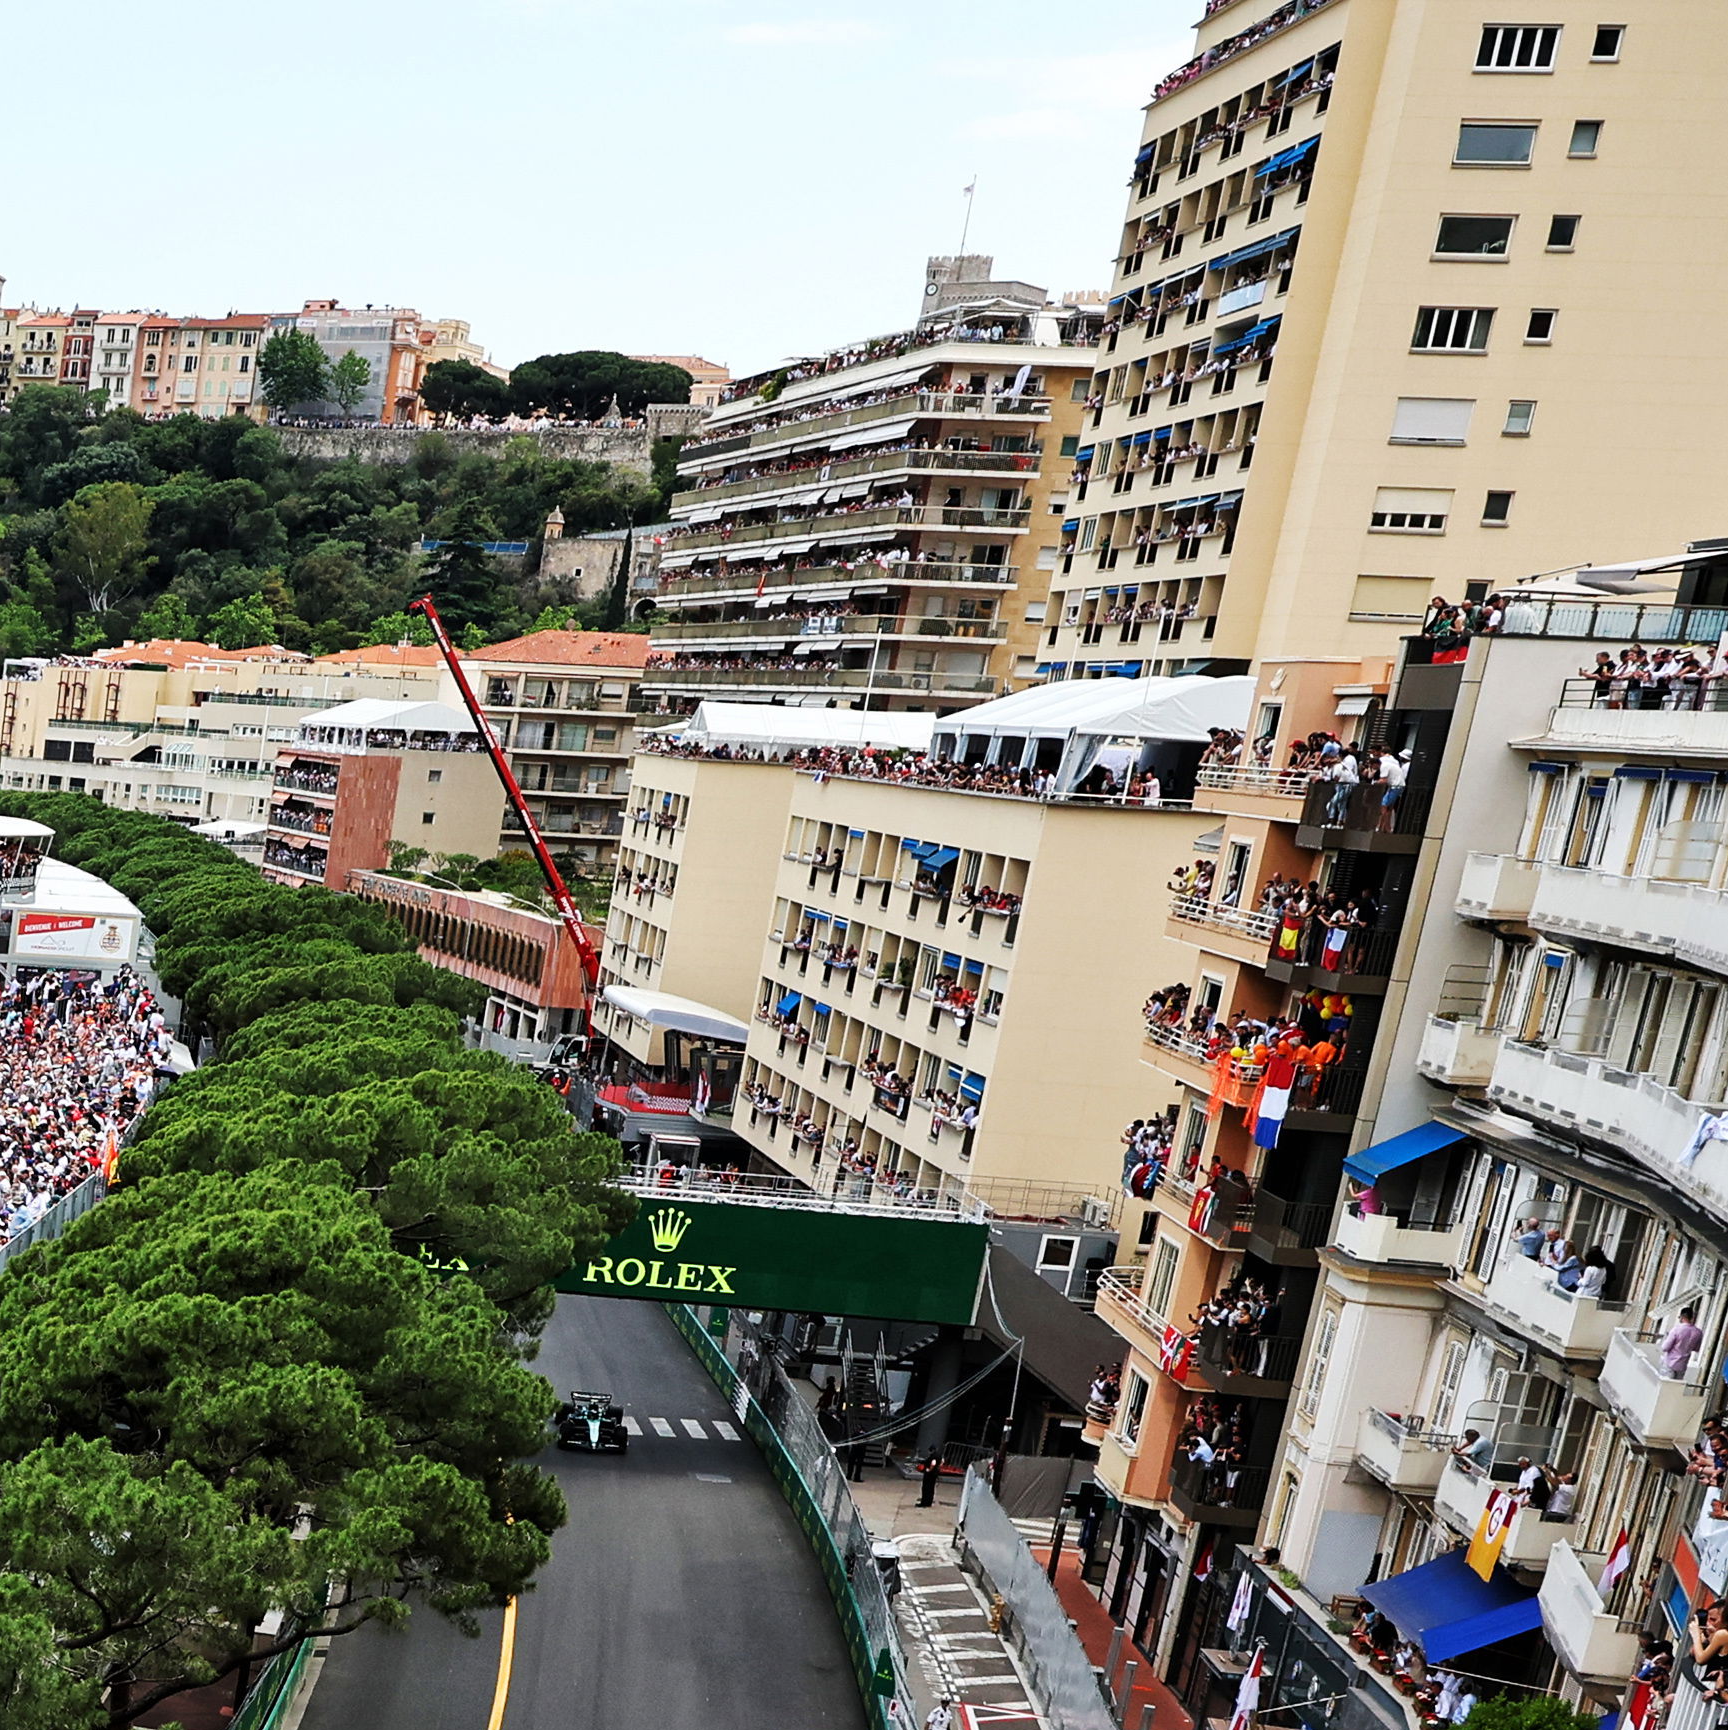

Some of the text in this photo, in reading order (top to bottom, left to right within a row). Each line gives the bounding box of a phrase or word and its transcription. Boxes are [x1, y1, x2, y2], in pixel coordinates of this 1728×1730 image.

[24, 920, 83, 933] BIENVENUE WELCOME
[582, 1257, 737, 1294] ROLEX
